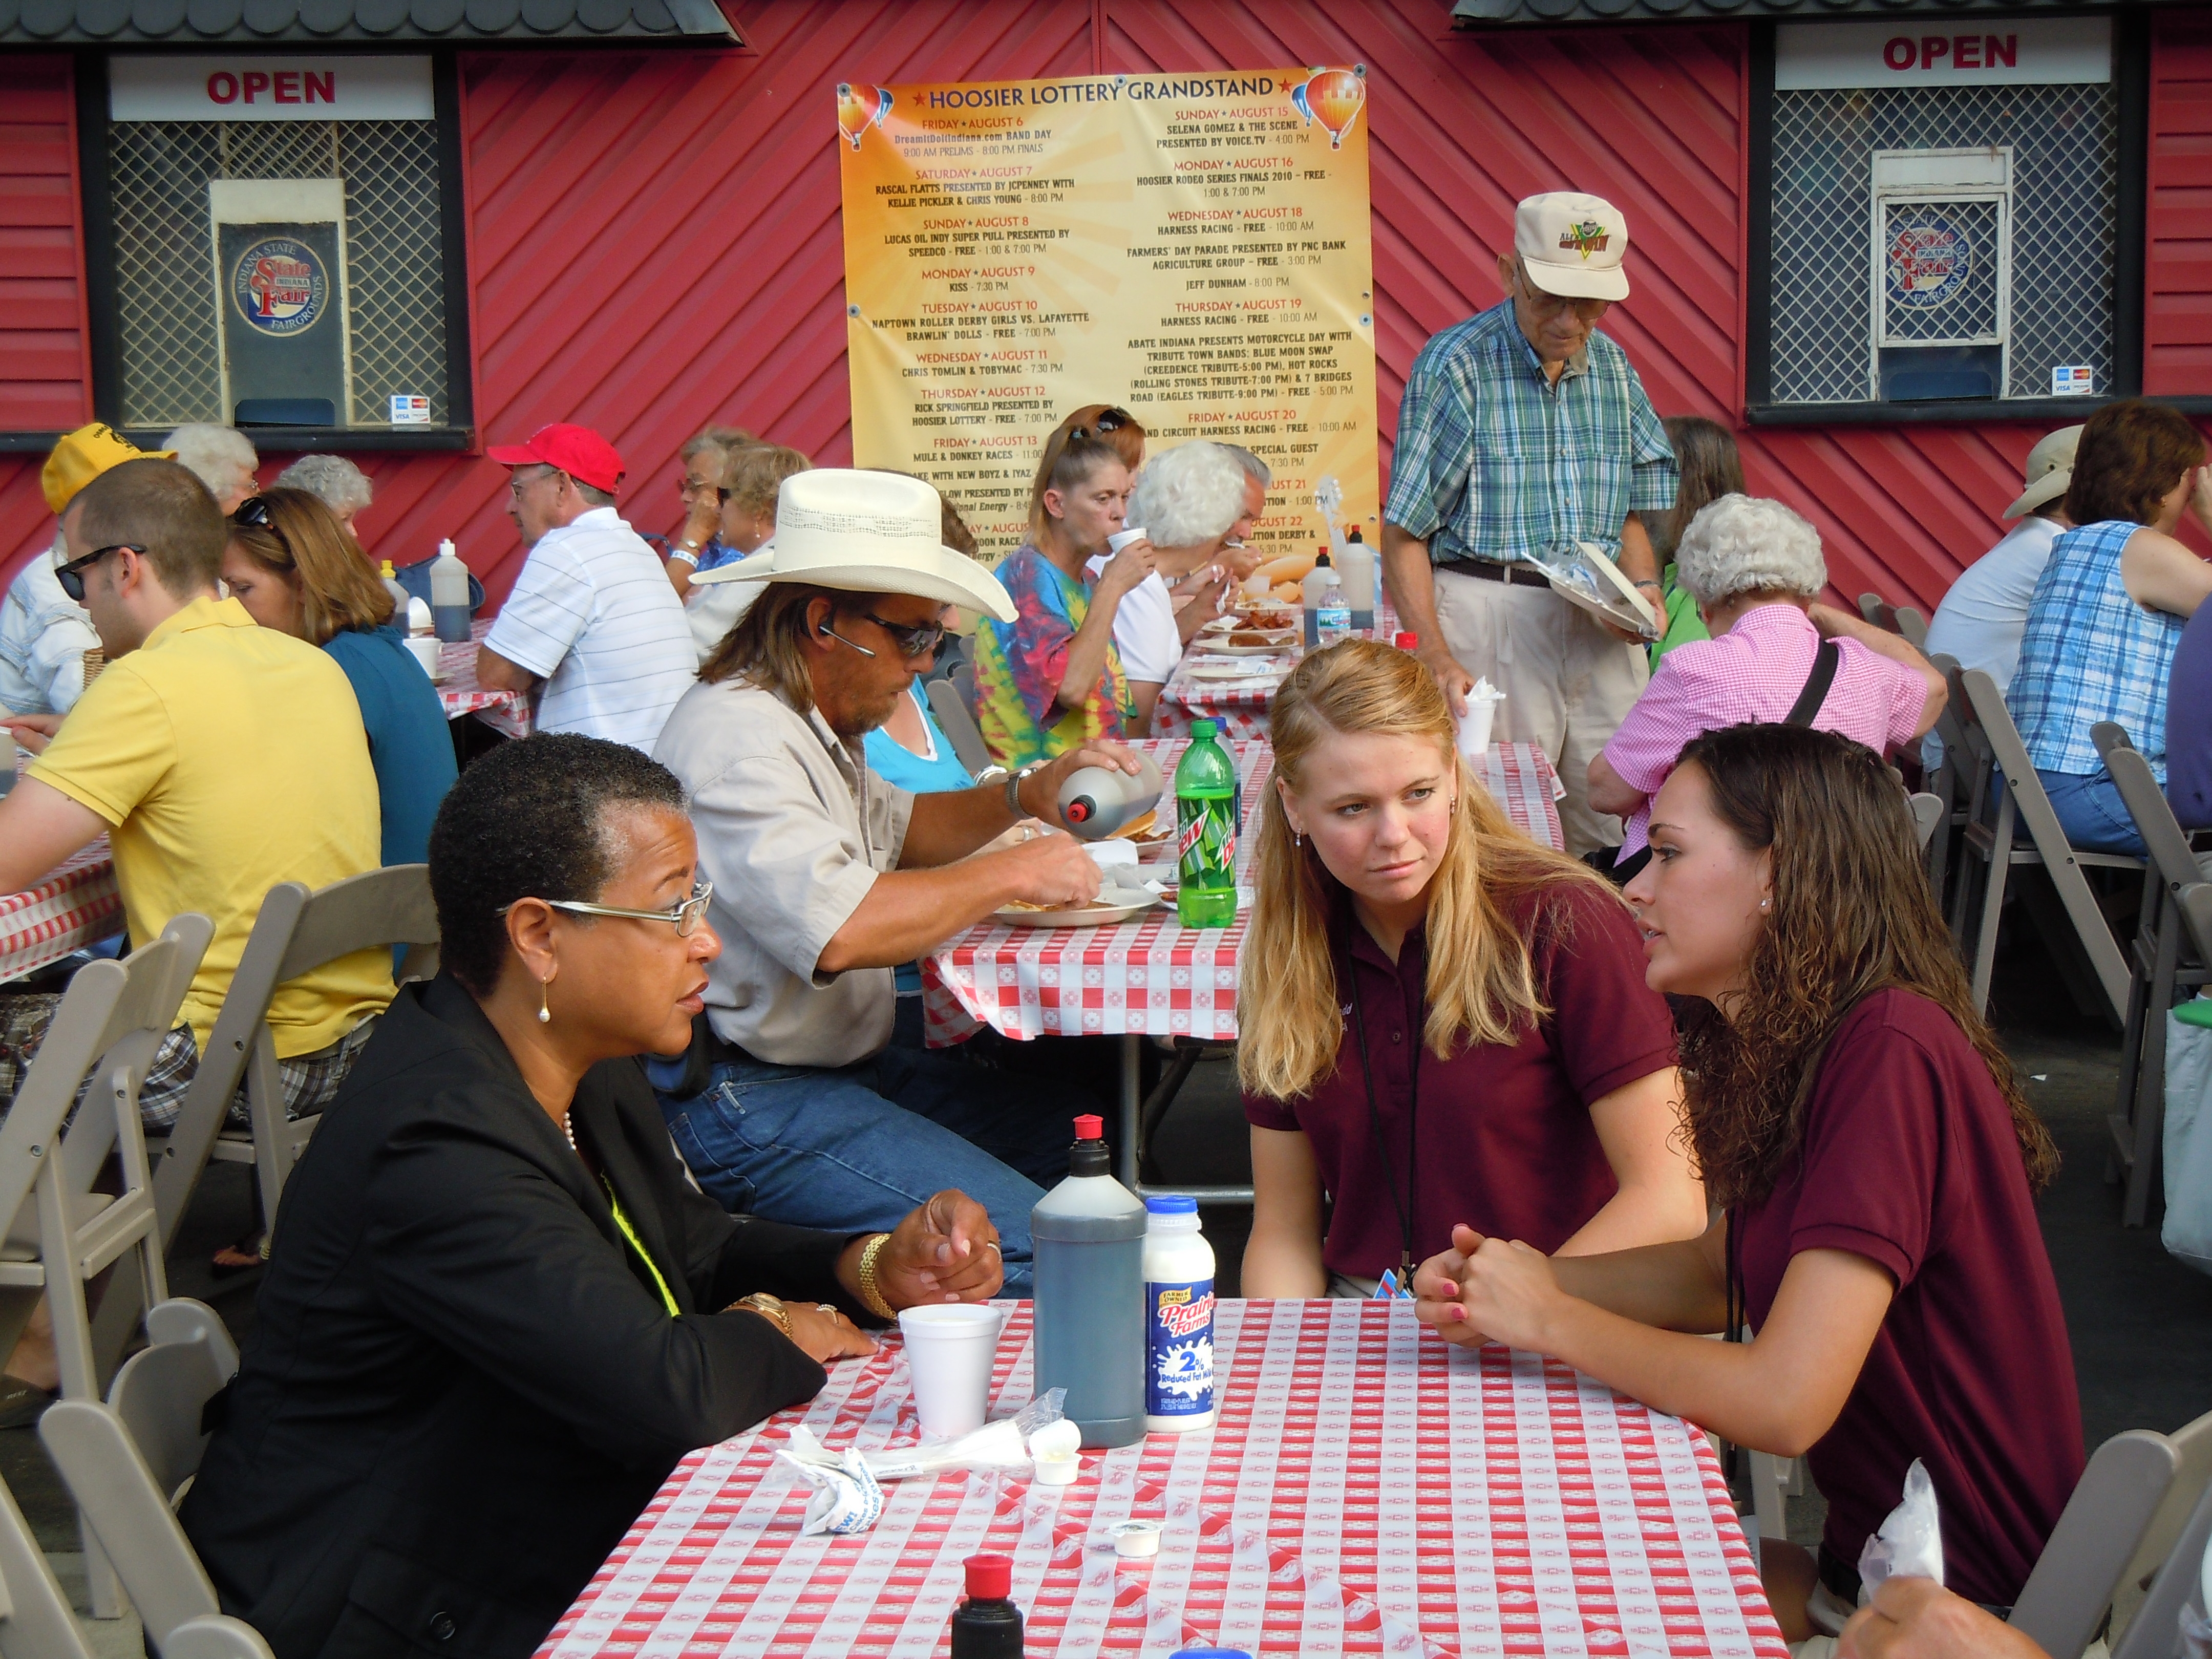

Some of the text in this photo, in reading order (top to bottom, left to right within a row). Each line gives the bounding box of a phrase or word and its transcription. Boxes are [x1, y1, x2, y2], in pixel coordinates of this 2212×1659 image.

[1883, 35, 2017, 71] OPEN
[207, 72, 336, 105] OPEN
[929, 78, 1273, 109] HOOSIER LOTTERY GRANDSTAND
[1176, 108, 1274, 120] SUNDAY AUGUST
[923, 118, 1012, 129] FRIDAY AUGUST
[1167, 121, 1298, 134] SELENA GOMEZ SCENE
[1006, 131, 1031, 140] BAND
[1157, 136, 1265, 148] PRESENTED VOICE.TV
[940, 144, 1043, 156] PRELIMS FINALS
[1174, 158, 1278, 170] MONDAY AUGUST
[916, 167, 1023, 180] SATURDAY AUGUST
[1137, 172, 1292, 186] HOOSIER RODEO SERIES FINALS 2010
[876, 179, 1074, 194] RASCAL FLATTS PRESENTED JCPENNEY WITH
[888, 195, 1022, 207] KELLIE PICKLER CHRIS YOUNG
[1168, 208, 1287, 221] WEDNESDAY AUGUST
[924, 217, 1018, 229] SUNDAY AUGUST
[1158, 224, 1233, 236] HARNESS RACING
[885, 230, 1055, 244] LUCAS INDY SUPER PULL PRESENTED
[264, 244, 296, 255] STATE
[909, 246, 975, 257] SPEEDCO FREE
[1195, 245, 1228, 255] PARADE
[1232, 243, 1283, 253] PRESENTED
[1322, 241, 1346, 250] BANK
[252, 258, 311, 281] State
[1153, 258, 1245, 270] AGRICULTURE GROUP
[922, 267, 1024, 279] MONDAY AUGUST
[276, 278, 310, 287] INDIANA
[949, 283, 968, 292] KISS
[1186, 279, 1246, 290] JEFF DUNHAM
[257, 285, 311, 317] Fair
[271, 275, 323, 329] FAIRGROUNDS
[1176, 300, 1286, 312] THURSDAY AUGUST
[922, 302, 1023, 313] TUESDAY AUGUST
[873, 313, 1089, 329] NAPTOWN ROLLER DERBY GIRLS LAFAYETTE
[1161, 315, 1237, 326] HARNESS RACING
[954, 330, 982, 339] DOLLS
[993, 329, 1015, 338] FREE
[1128, 332, 1352, 349] ABATE INDIANA PRESENTS MOTORCYCLE WITH
[917, 351, 1035, 363] WEDNESDAY AUGUST
[1147, 346, 1333, 361] TRIBUTE TOWN BANDS: BLUE MOON SWAP
[902, 365, 1022, 377] CHRIS TOMLIN TOBYMAC
[1144, 364, 1198, 375] (CREEDENCE
[1309, 360, 1337, 369] ROCKS
[1131, 378, 1171, 389] (ROLLING
[1174, 377, 1207, 388] STONES
[1314, 372, 1352, 382] BRIDGES
[922, 387, 1031, 398] THURSDAY AUGUST
[1131, 393, 1153, 402] ROAD
[1157, 391, 1194, 401] (EAGLES
[915, 400, 1039, 413] RICK SPRINGFIELD PRESENTED
[913, 415, 1015, 426] HOOSIER LOTTERY FREE
[1188, 411, 1279, 422] FRIDAY AUGUST
[1163, 425, 1275, 438] CIRCUIT HARNESS RACING
[934, 437, 1024, 448] FRIDAY AUGUST
[1250, 444, 1318, 454] SPECIAL GUEST
[914, 451, 1012, 462] MULE DONKEY RACES
[932, 469, 1031, 481] WITH BOYZ IYAZ
[965, 488, 1010, 498] PRESENTED
[980, 501, 1007, 511] Energy
[999, 537, 1020, 546] RACE
[1279, 531, 1306, 540] DERBY
[1163, 1290, 1188, 1299] FARMER
[1171, 1314, 1209, 1336] Farms
[1179, 1351, 1204, 1372] 2%
[1161, 1373, 1192, 1383] Reduced
[1193, 1372, 1201, 1380] Fat
